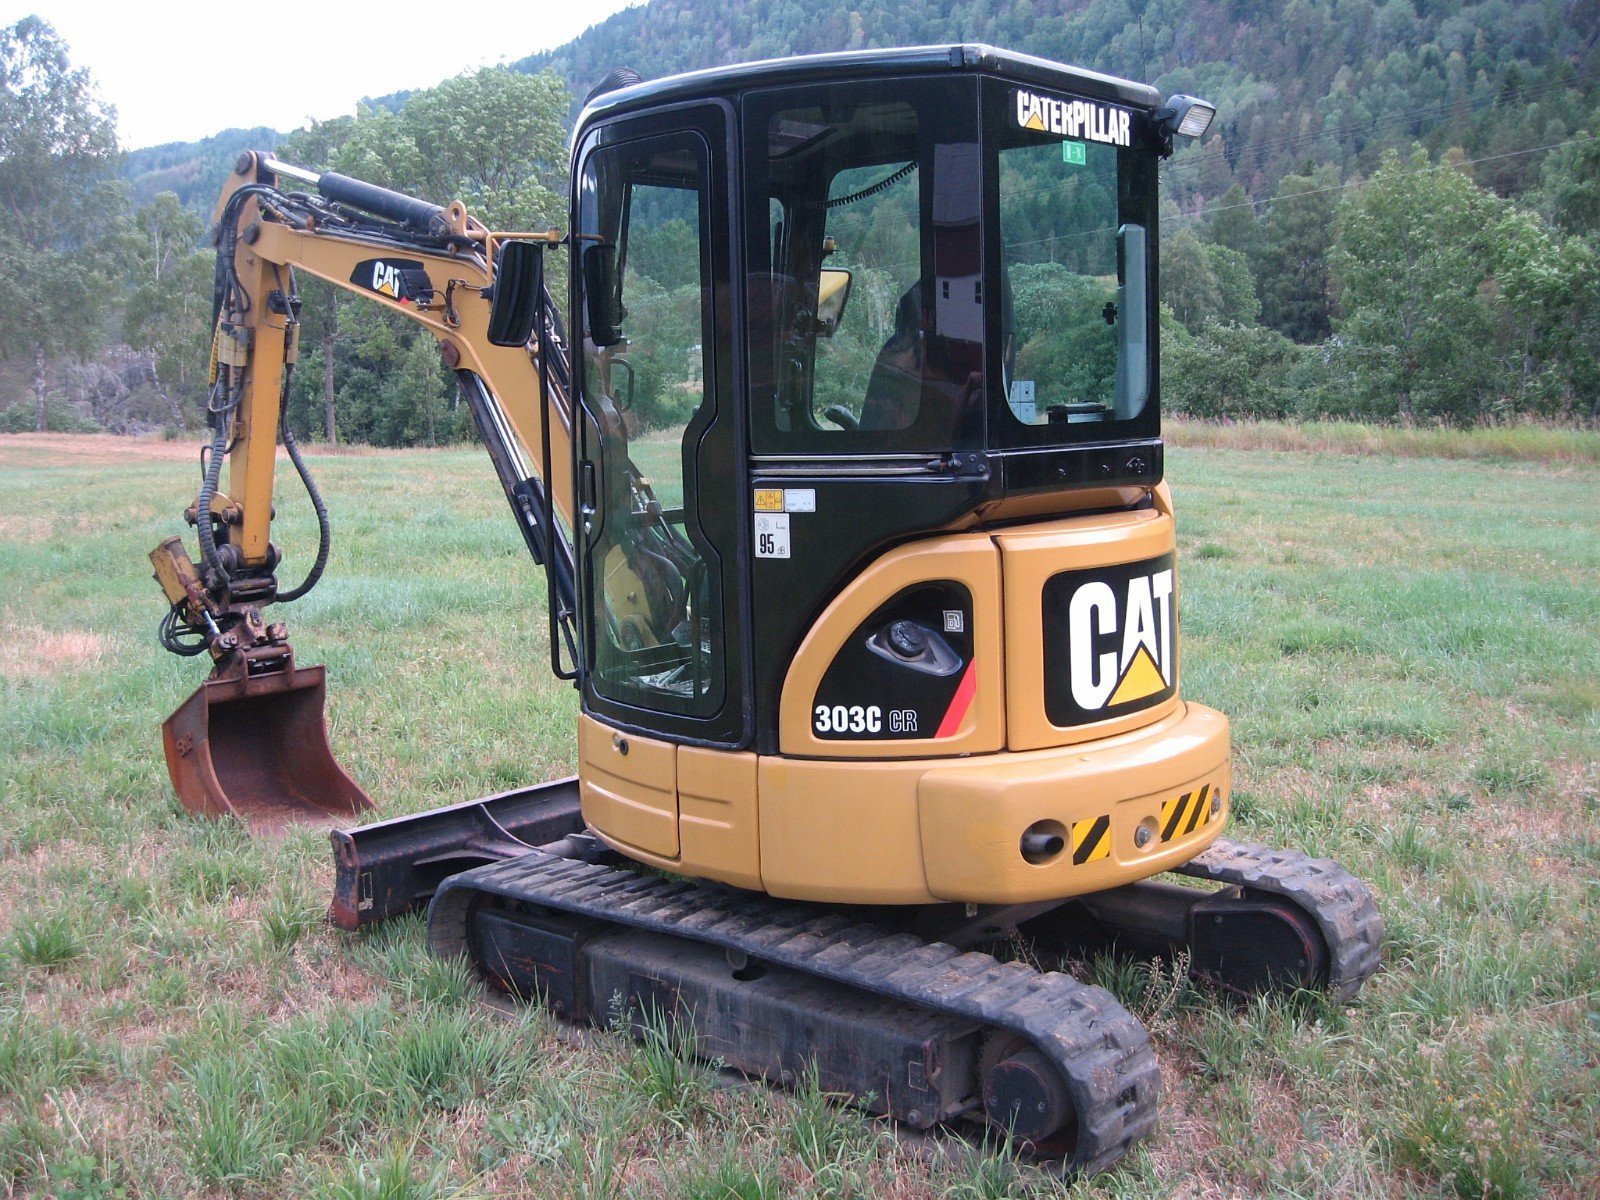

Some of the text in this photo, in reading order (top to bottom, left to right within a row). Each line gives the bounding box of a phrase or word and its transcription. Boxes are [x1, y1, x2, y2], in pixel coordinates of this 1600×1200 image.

[1017, 90, 1131, 147] CATERPILLAR
[373, 262, 400, 298] CAT
[760, 533, 786, 555] 95 dB
[1069, 569, 1173, 710] CAT
[815, 705, 918, 733] 303C CR
